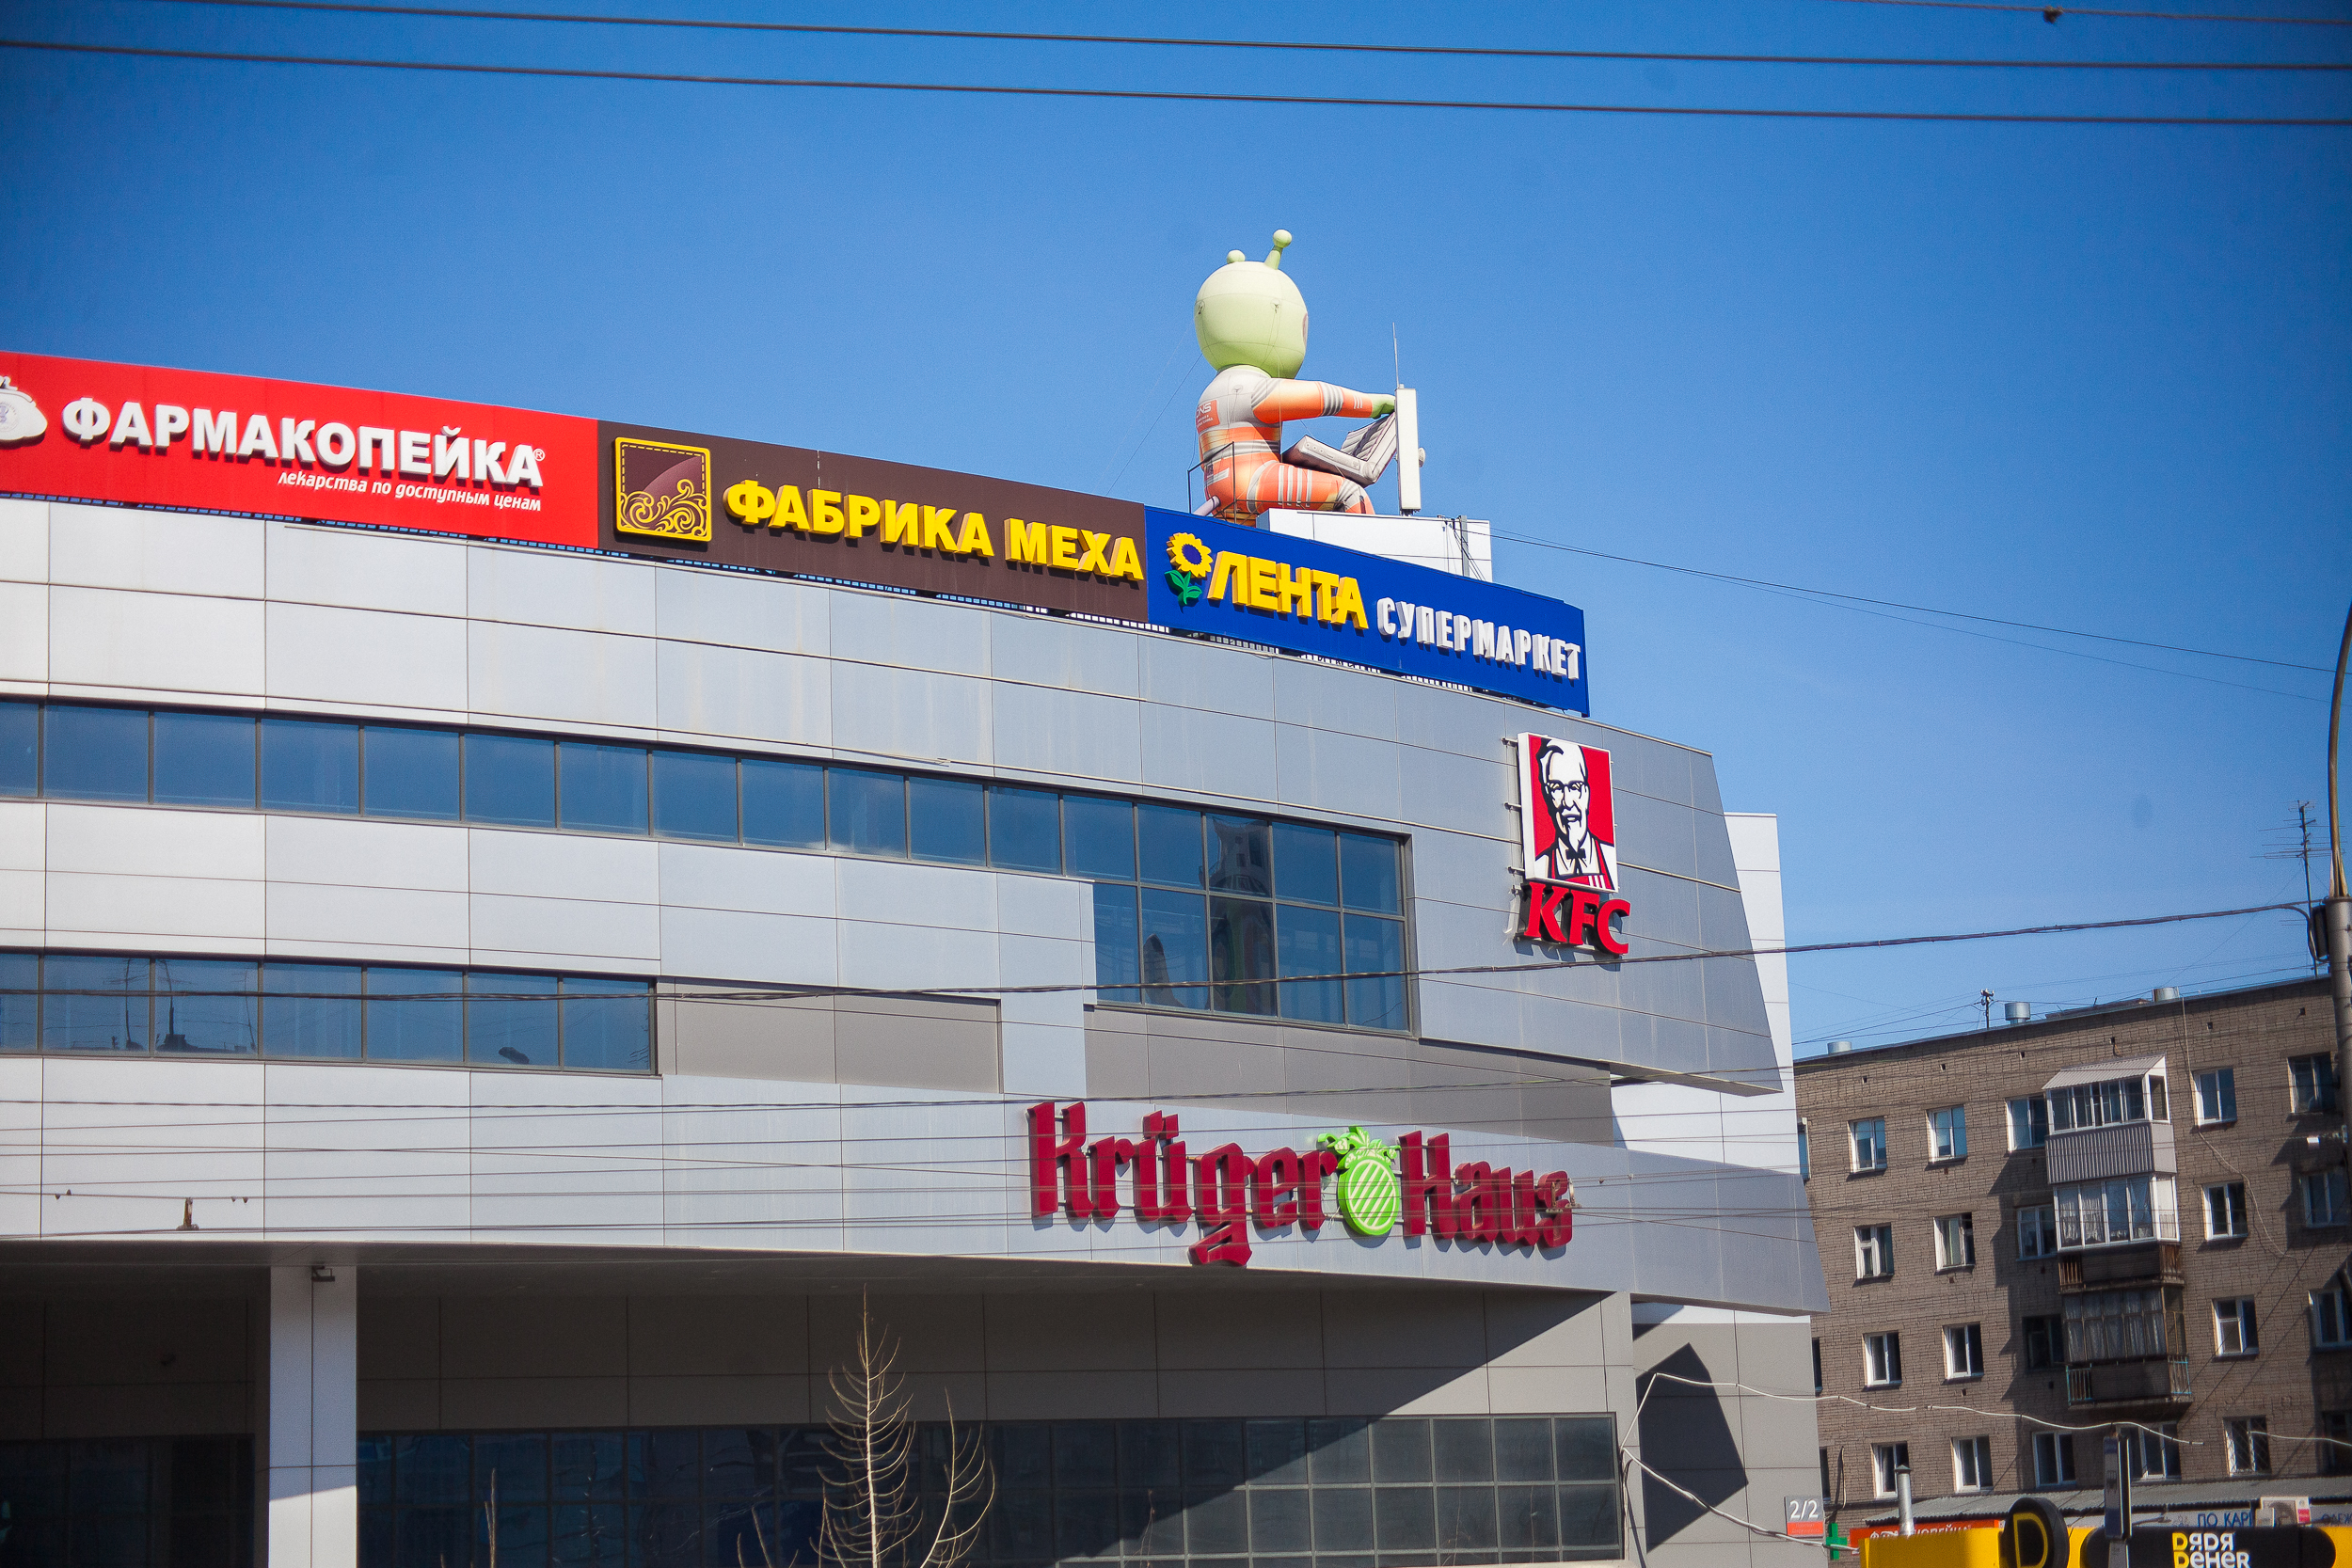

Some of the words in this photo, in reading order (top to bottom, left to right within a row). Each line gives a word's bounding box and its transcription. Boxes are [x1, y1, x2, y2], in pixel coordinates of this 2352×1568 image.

[61, 397, 544, 487] ФАРМАКОПЕЙКА
[278, 469, 367, 493] лекарства
[372, 478, 392, 495] по
[395, 482, 490, 506] доступным
[494, 493, 542, 512] ценам
[723, 480, 994, 557] ФАБРИКА
[1004, 517, 1144, 580] МЕХА
[1207, 550, 1369, 630] ЛЕНТА
[1376, 596, 1581, 680] СУПЕРМАРКЕТ
[1523, 880, 1630, 955] KFC
[1027, 1101, 1338, 1266] Krüger
[1398, 1130, 1575, 1248] Haus
[1789, 1499, 1819, 1520] 2/2
